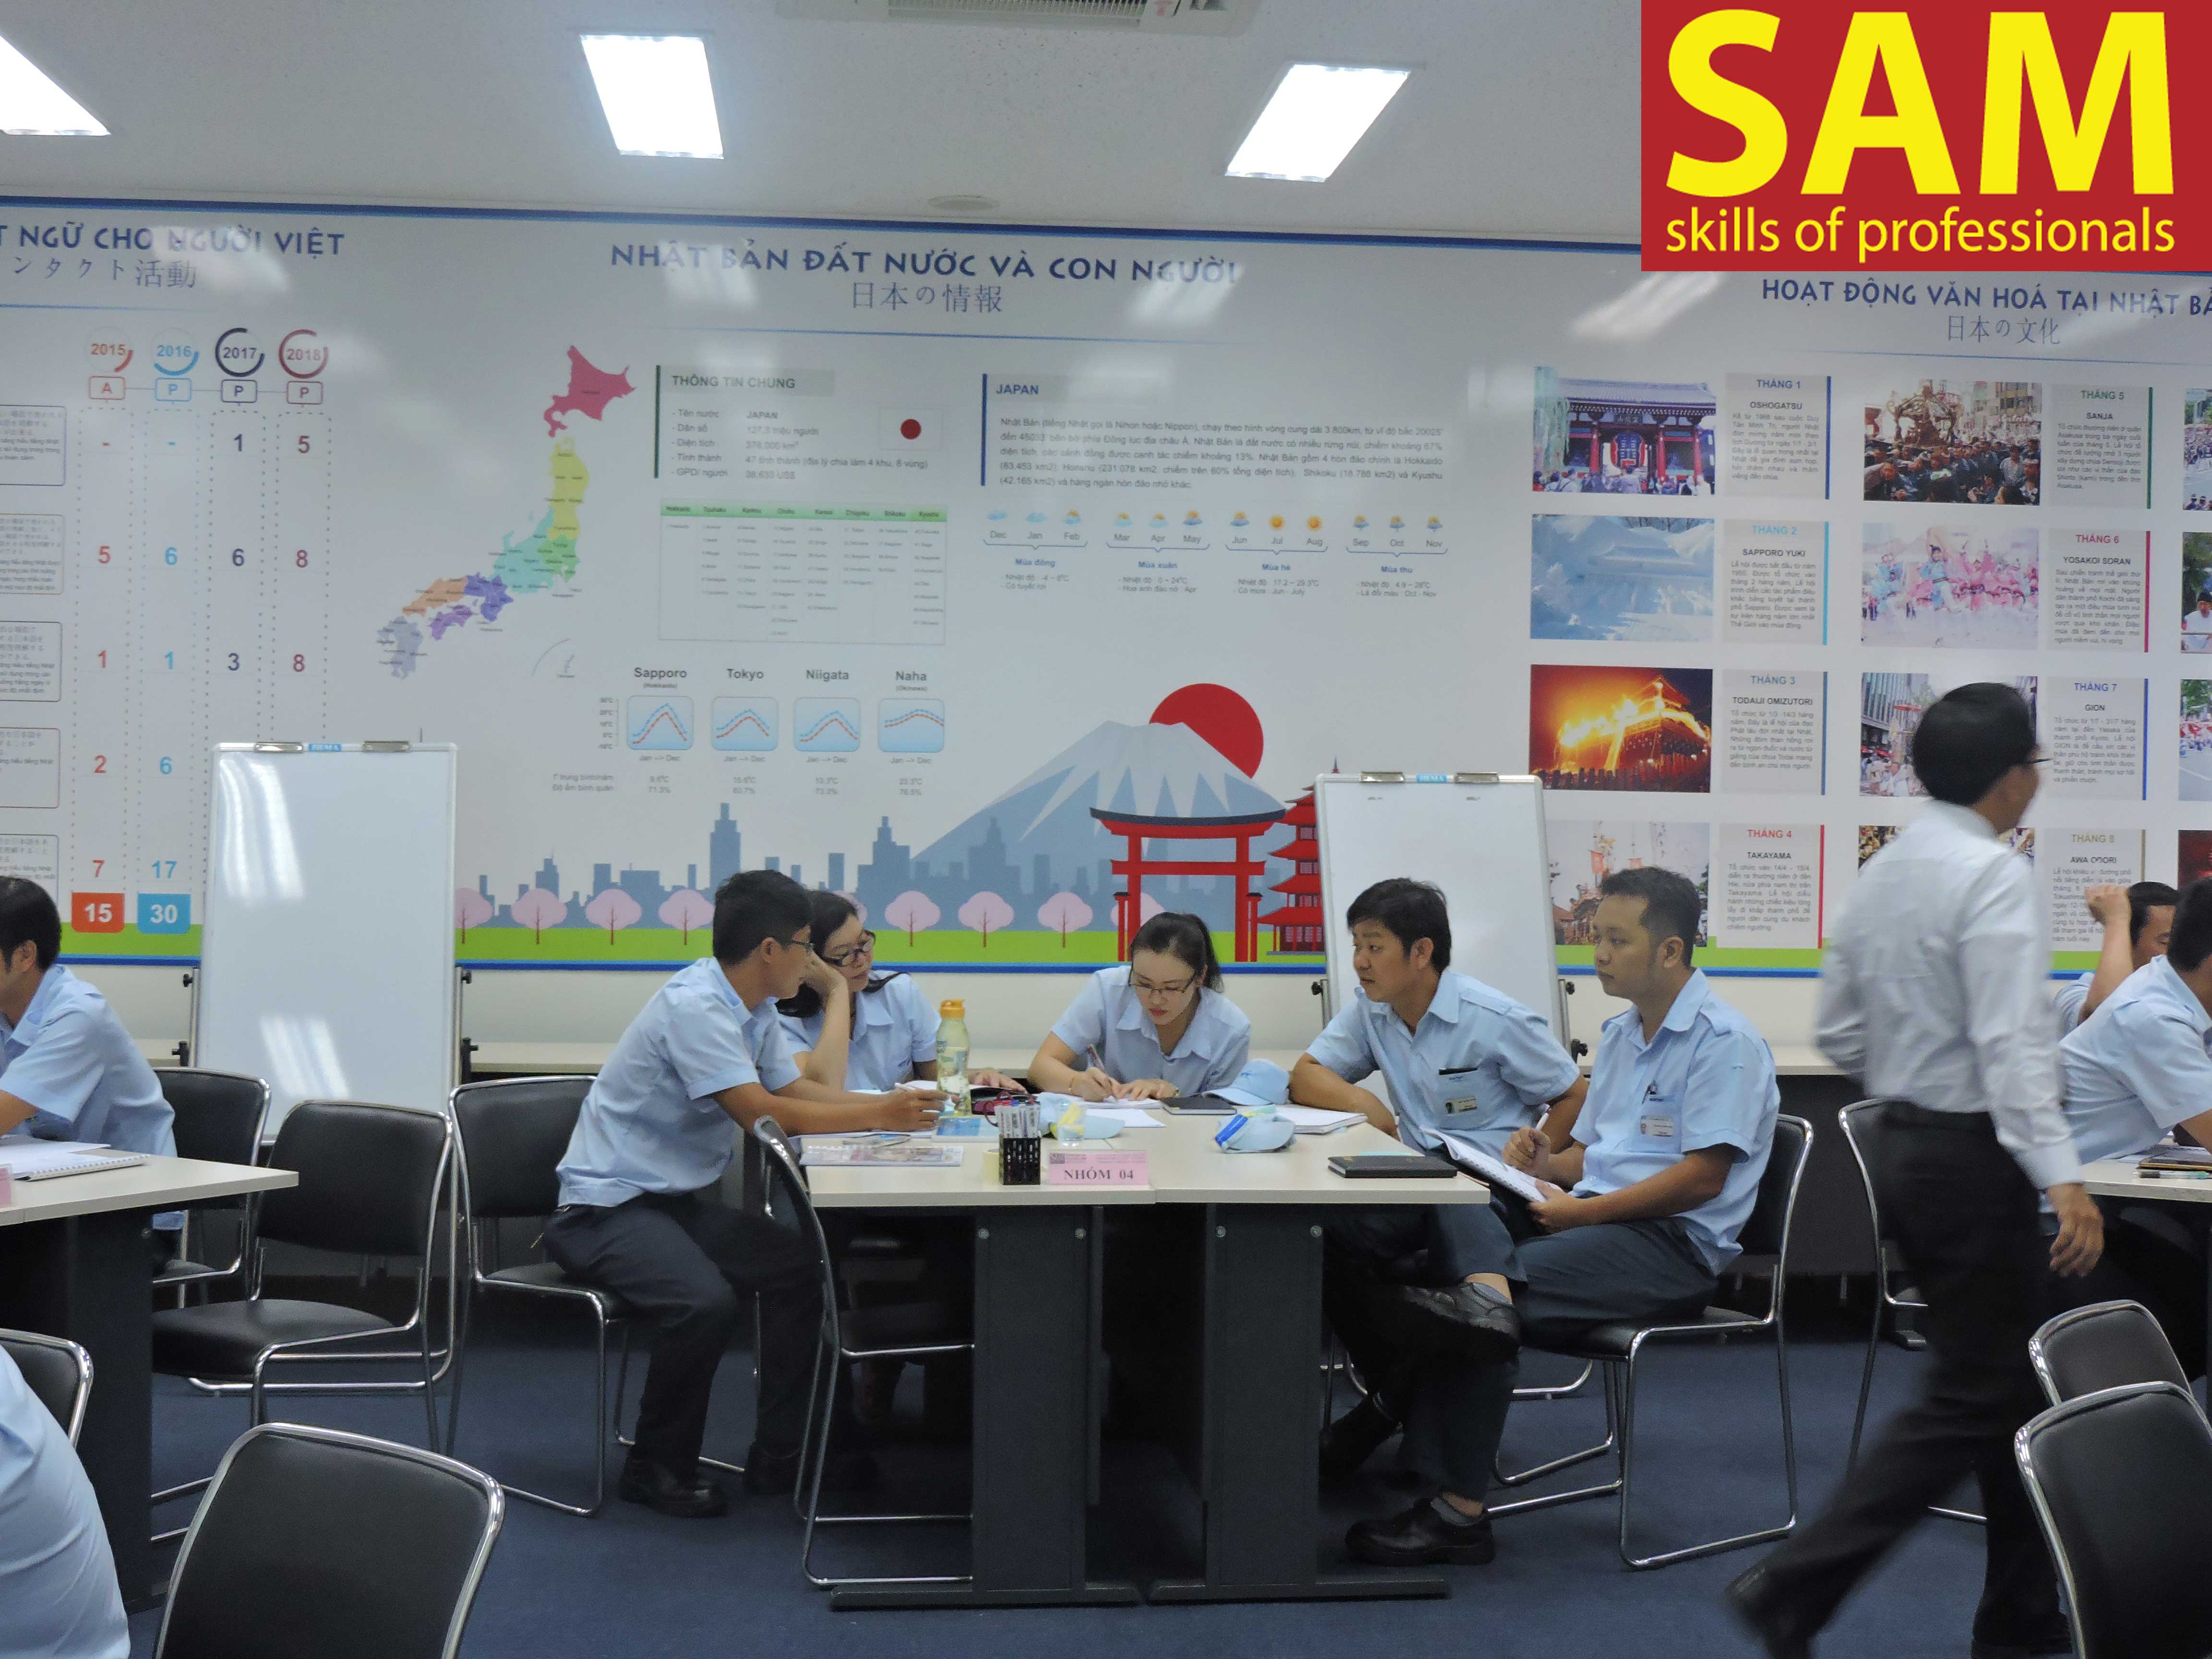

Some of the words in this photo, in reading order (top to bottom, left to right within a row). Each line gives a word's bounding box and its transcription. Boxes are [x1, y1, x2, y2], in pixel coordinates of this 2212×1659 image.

[20, 221, 84, 249] NGỮ
[95, 228, 153, 250] CHO
[275, 227, 345, 259] VIỆT
[611, 240, 707, 272] NHẬT
[721, 239, 789, 271] BẢN
[802, 241, 871, 273] ĐẤT
[885, 248, 976, 276] NƯỚC
[990, 250, 1035, 278] VÀ
[1049, 258, 1117, 280] CON
[1131, 255, 1236, 284] NGƯỜI
[853, 281, 1003, 313] 日本の情報
[1762, 279, 1835, 307] HOẠT
[1843, 277, 1917, 306] ĐỘNG
[1926, 282, 1982, 308] VĂN
[1992, 284, 2047, 311] HOÁ
[2060, 290, 2099, 320] TẠI
[2110, 289, 2179, 319] NHẬT
[1947, 315, 2061, 345] 日本の文化
[91, 344, 126, 356] 2015
[156, 345, 192, 358] 2016
[222, 347, 257, 360] 2017
[287, 348, 321, 361] 2018
[722, 376, 744, 387] TIN
[747, 377, 796, 388] CHUNG
[1757, 379, 1792, 389] THÁNG
[101, 382, 113, 395] A
[168, 383, 179, 395] P
[234, 385, 244, 397] P
[300, 386, 310, 399] P
[996, 384, 1039, 395] JAPAN
[2081, 389, 2116, 399] THÁNG
[2118, 392, 2125, 400] 5
[1750, 401, 1803, 410] OSHOGATSU
[234, 434, 242, 452] 1
[298, 435, 311, 453] 5
[1791, 526, 1796, 535] 2
[989, 530, 1007, 539] Dec
[1064, 532, 1080, 540] Feb
[1151, 534, 1166, 542] Apr
[1183, 535, 1202, 544] May
[1306, 538, 1323, 547] Aug
[1352, 538, 1369, 547] Sep
[2076, 533, 2111, 543] THÁNG
[2114, 535, 2119, 543] 6
[98, 546, 111, 564] 5
[165, 547, 178, 565] 6
[232, 548, 245, 566] 6
[296, 550, 309, 568] 8
[98, 650, 107, 668] 1
[165, 651, 174, 669] 1
[228, 652, 240, 671] 3
[293, 654, 305, 672] 8
[634, 667, 687, 680] Sapporo
[727, 669, 764, 681] Tokyo
[805, 669, 850, 682] Niigata
[895, 671, 927, 681] Naha
[1751, 674, 1786, 685] THÁNG
[2074, 682, 2109, 692] THÁNG
[2112, 684, 2117, 692] 7
[95, 755, 107, 774] 2
[160, 757, 172, 775] 6
[1747, 827, 1783, 838] THÁNG
[2071, 832, 2106, 843] THÁNG
[93, 860, 105, 878] 7
[152, 860, 178, 879] 17
[85, 903, 113, 923] 15
[150, 904, 178, 924] 30
[1064, 1166, 1111, 1180] NHÓM
[1119, 1170, 1134, 1179] 04
